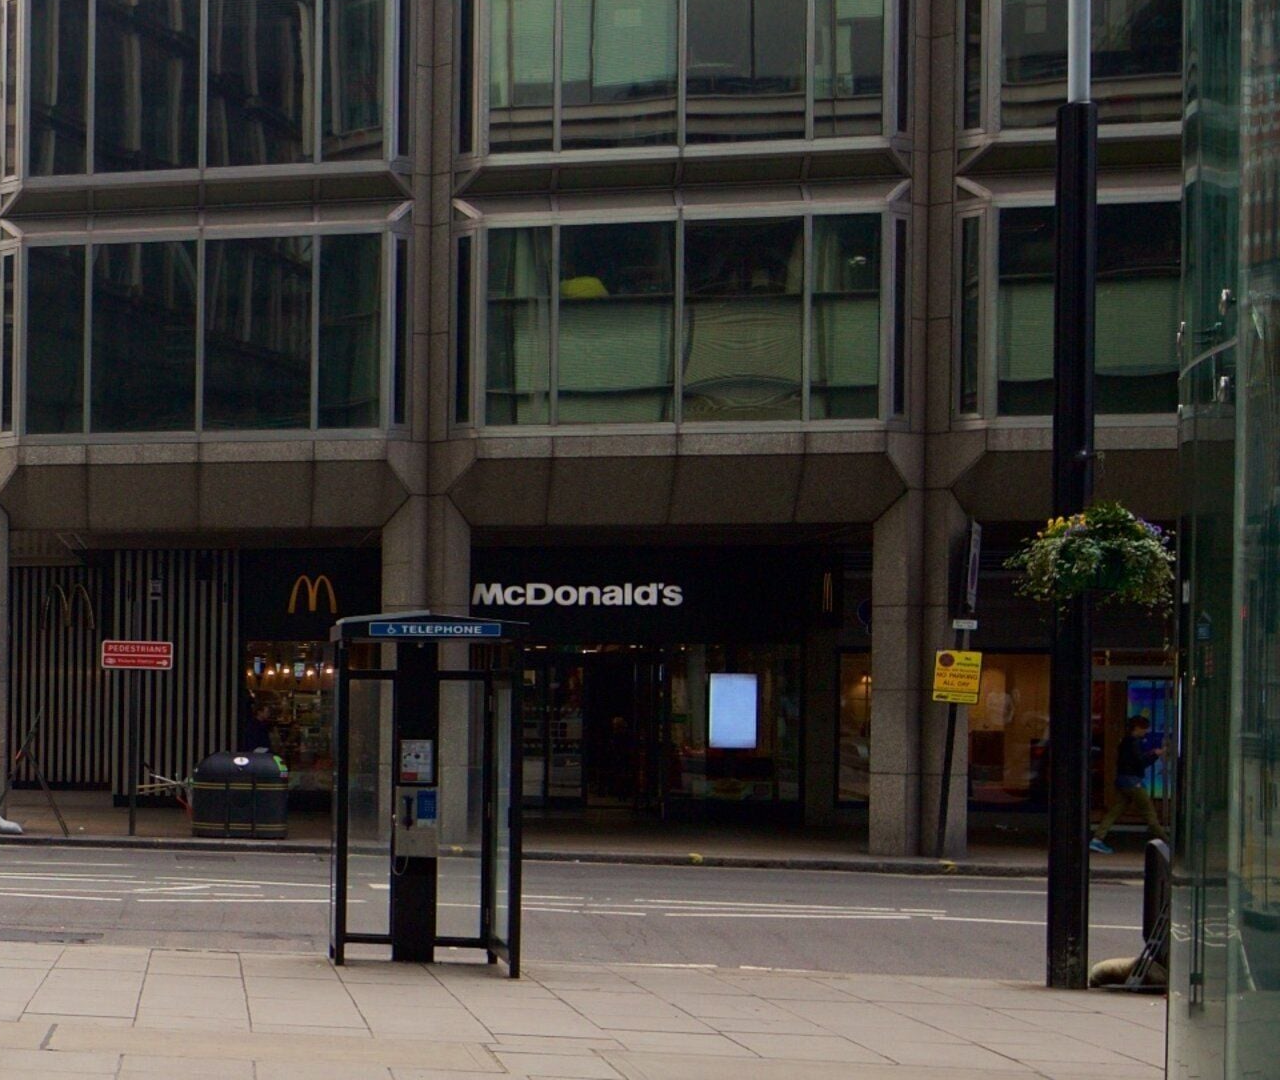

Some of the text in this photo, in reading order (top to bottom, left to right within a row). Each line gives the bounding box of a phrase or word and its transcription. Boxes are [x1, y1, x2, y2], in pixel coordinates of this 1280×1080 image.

[471, 583, 684, 606] McDonald's
[401, 625, 482, 634] TELEPHONE
[107, 644, 168, 653] PEDESTRIANS
[949, 673, 978, 681] PARKING
[942, 679, 970, 688] ALL DAY
